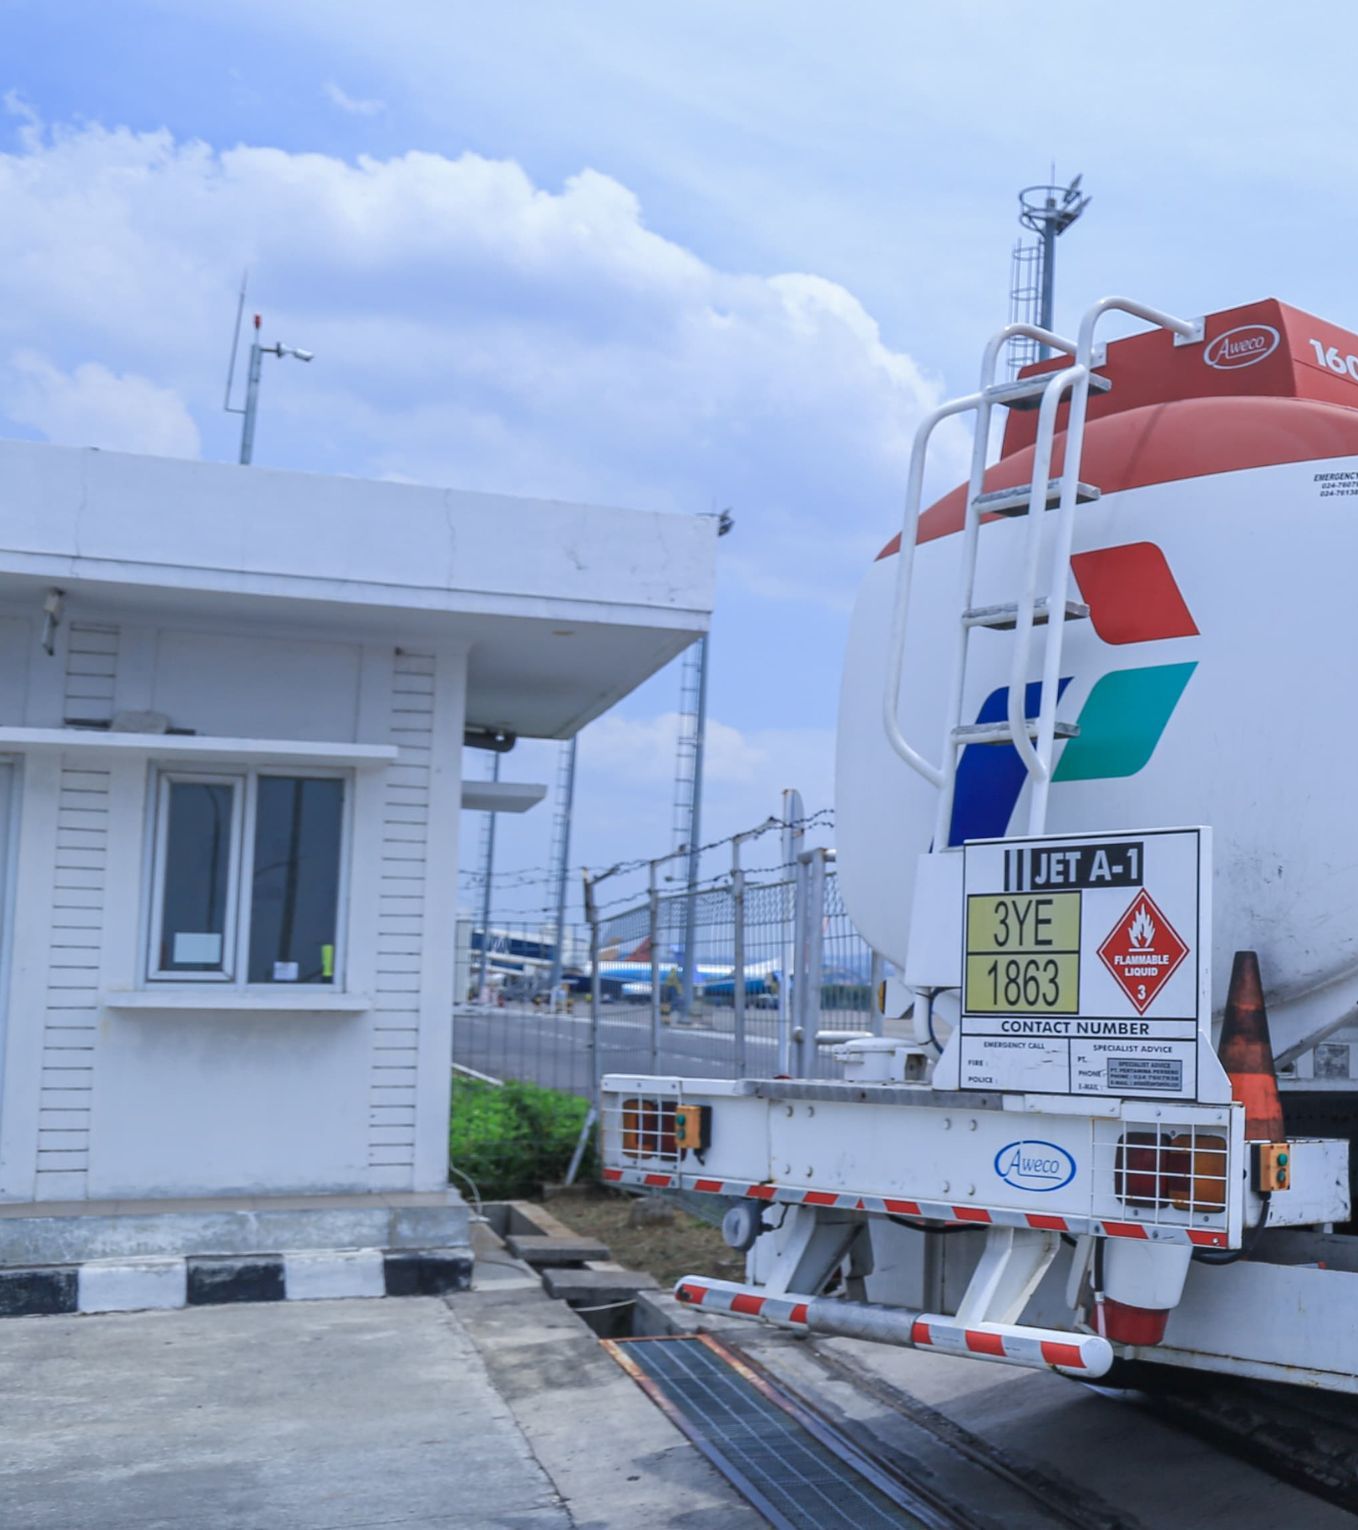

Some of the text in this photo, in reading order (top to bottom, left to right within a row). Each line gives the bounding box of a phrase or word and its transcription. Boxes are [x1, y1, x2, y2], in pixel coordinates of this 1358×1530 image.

[1034, 848, 1139, 885] JET A-1
[993, 898, 1054, 948] 3YE
[1114, 954, 1170, 966] FLAMMABLE
[1124, 967, 1159, 977] LIQUID
[987, 958, 1060, 1007] 1863
[1137, 984, 1147, 1000] 3
[1001, 1020, 1150, 1036] CONTACT NUMBER
[983, 1041, 1046, 1050] EMERGENCY CALL
[1093, 1044, 1173, 1054] SPECIALIST ADVICE
[967, 1059, 984, 1067] FIRE
[1078, 1069, 1101, 1078] PHONE
[967, 1076, 994, 1084] POLICE
[1003, 1148, 1062, 1180] Aweco
